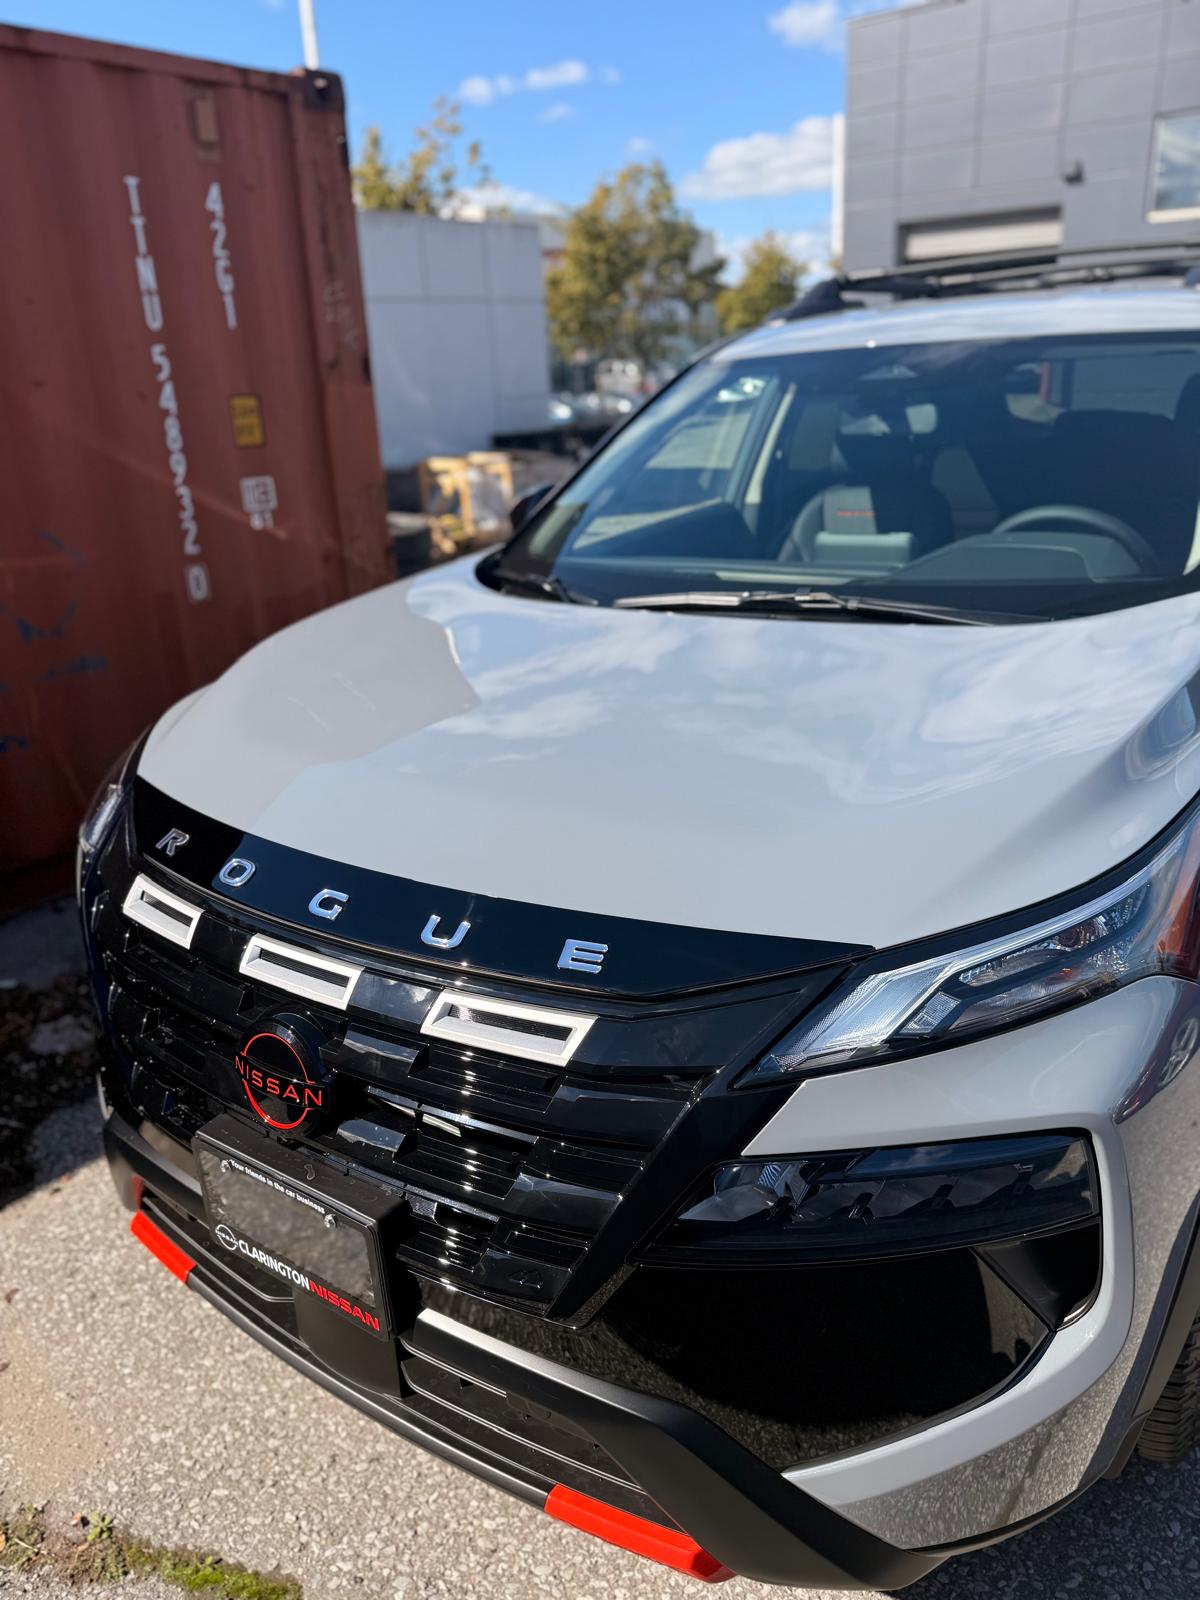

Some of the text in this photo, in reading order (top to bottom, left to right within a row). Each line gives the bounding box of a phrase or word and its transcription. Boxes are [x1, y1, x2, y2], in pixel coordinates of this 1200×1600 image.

[205, 181, 237, 330] 42G1
[123, 175, 163, 332] TTNU
[151, 343, 201, 555] 548932
[155, 827, 609, 975] ROGUE
[235, 1055, 322, 1107] NISSAN
[244, 1167, 266, 1183] friends
[266, 1178, 274, 1187] in
[273, 1181, 285, 1193] the
[285, 1188, 296, 1198] car
[296, 1193, 326, 1214] business
[309, 1280, 380, 1332] NISSAN
